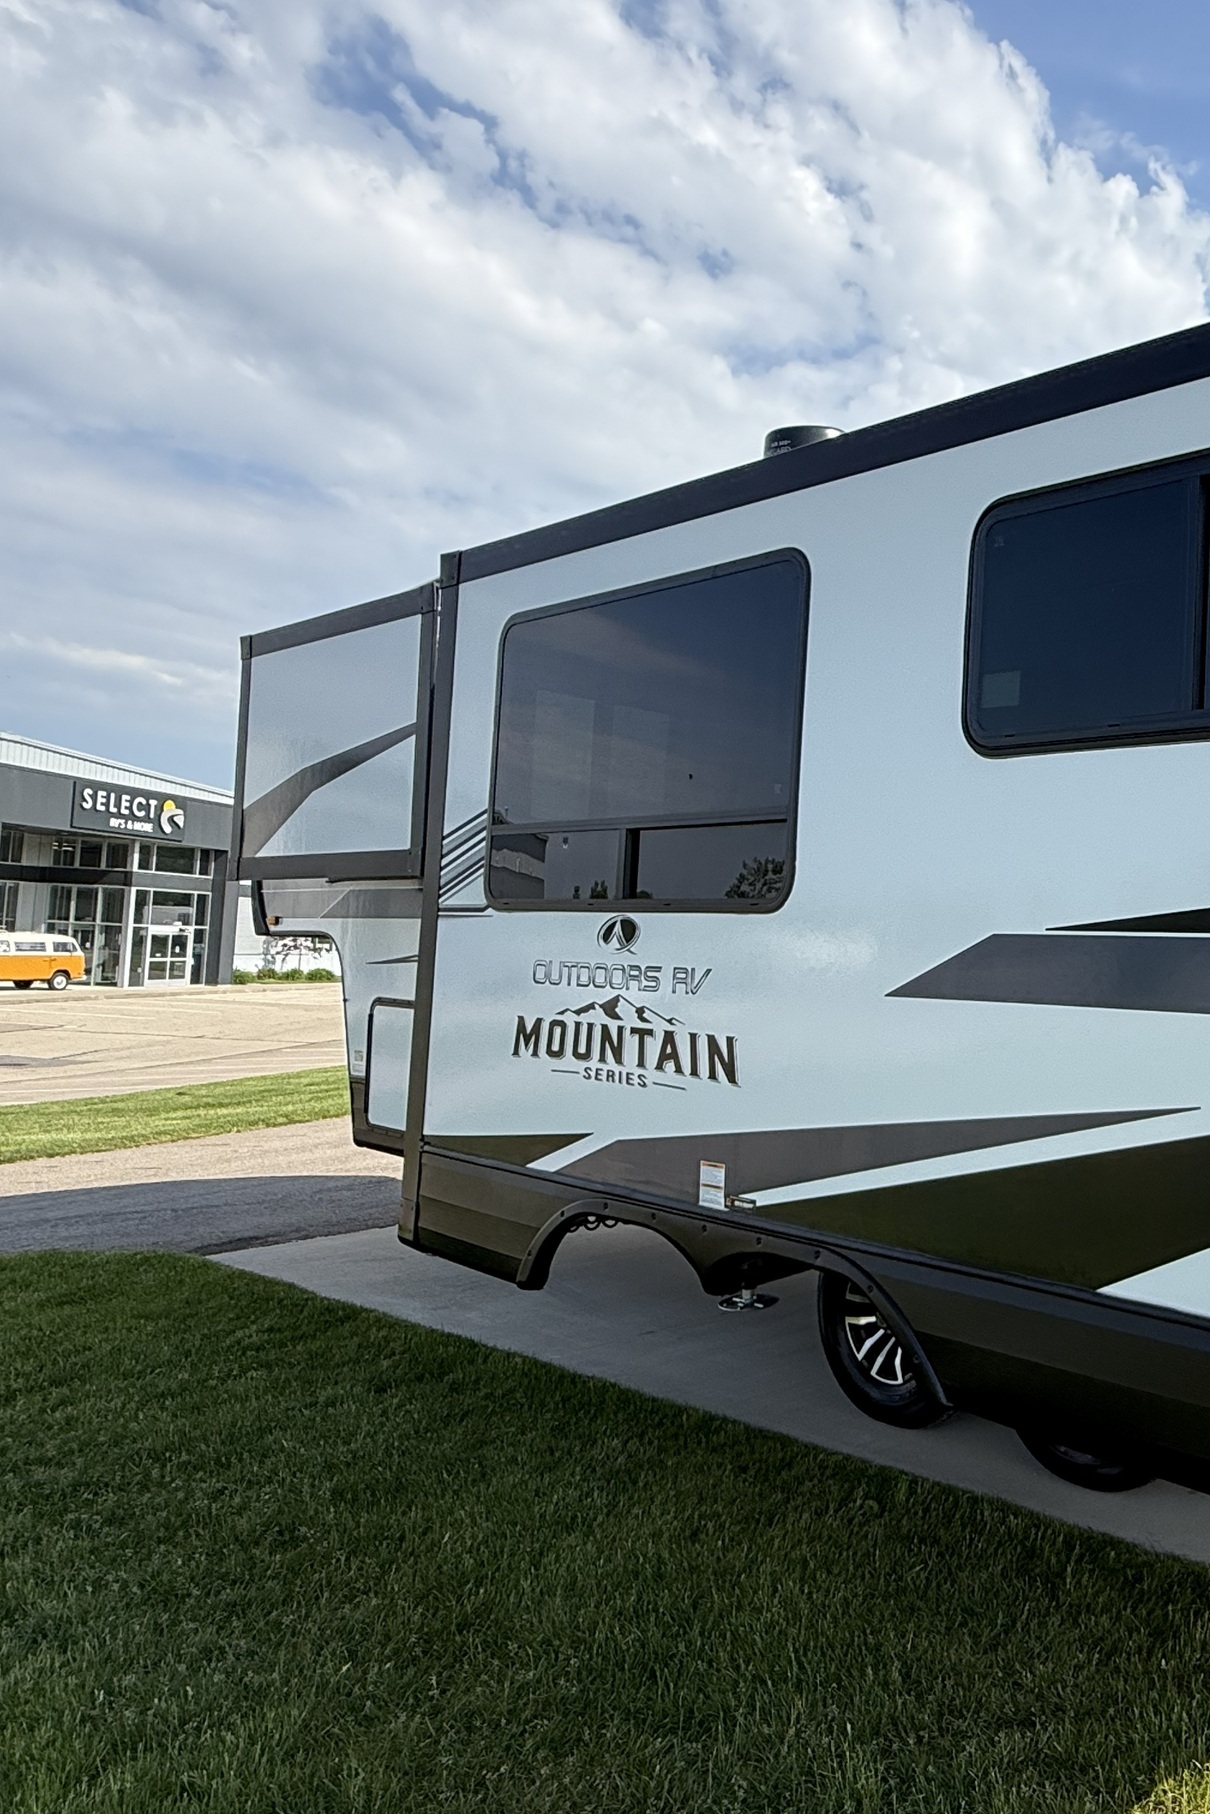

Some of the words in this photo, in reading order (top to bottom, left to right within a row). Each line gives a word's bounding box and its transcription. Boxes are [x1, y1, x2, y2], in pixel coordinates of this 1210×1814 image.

[81, 787, 158, 819] SELECT
[126, 819, 134, 831] &
[133, 820, 154, 833] MORE
[532, 959, 662, 993] OUTDOORS
[671, 966, 713, 995] RV
[511, 1015, 742, 1088] MOUNTAIN
[582, 1066, 649, 1089] SERIES
